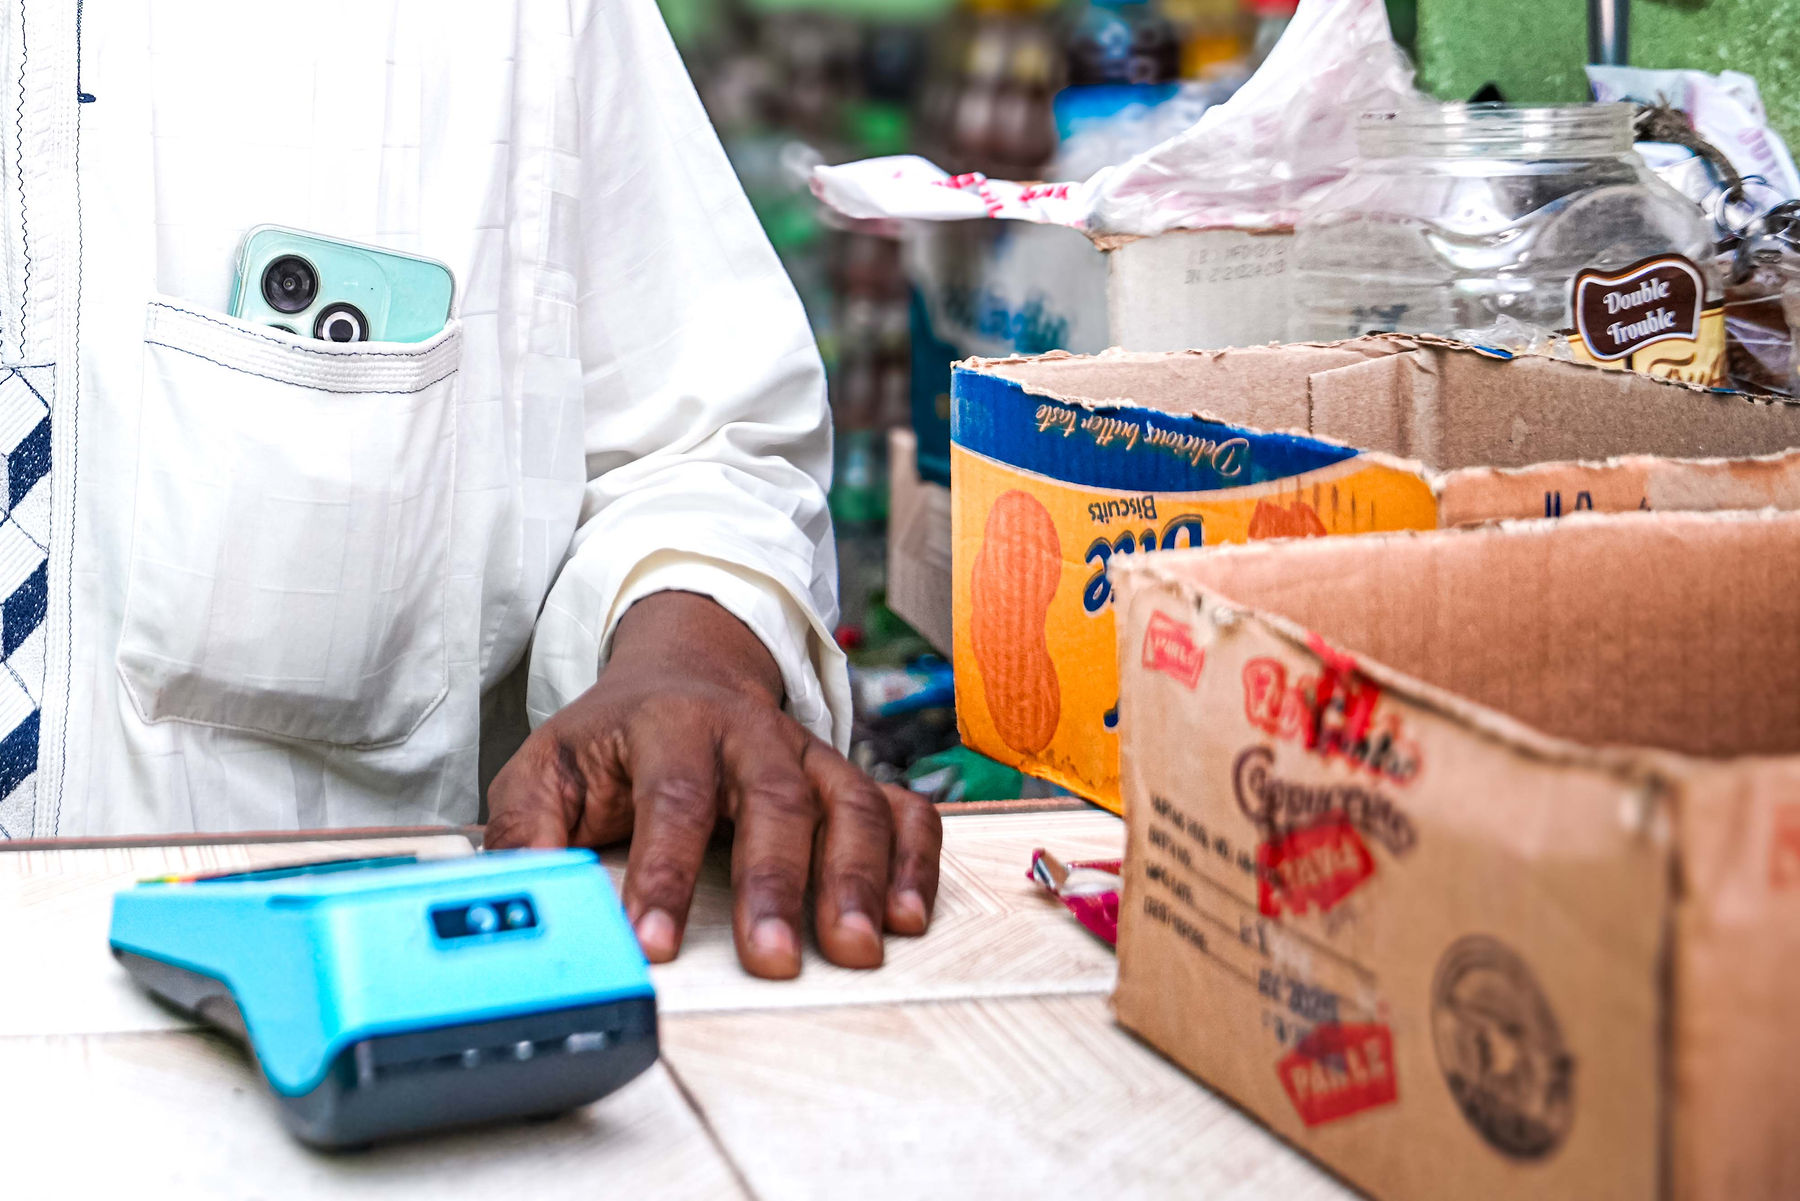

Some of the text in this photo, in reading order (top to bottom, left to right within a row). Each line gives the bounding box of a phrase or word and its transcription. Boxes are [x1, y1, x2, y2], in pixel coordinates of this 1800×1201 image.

[1602, 277, 1671, 315] Double
[1606, 306, 1677, 346] Trouble
[1034, 403, 1250, 478] Delicious butter taste
[1088, 494, 1159, 524] Biscuits
